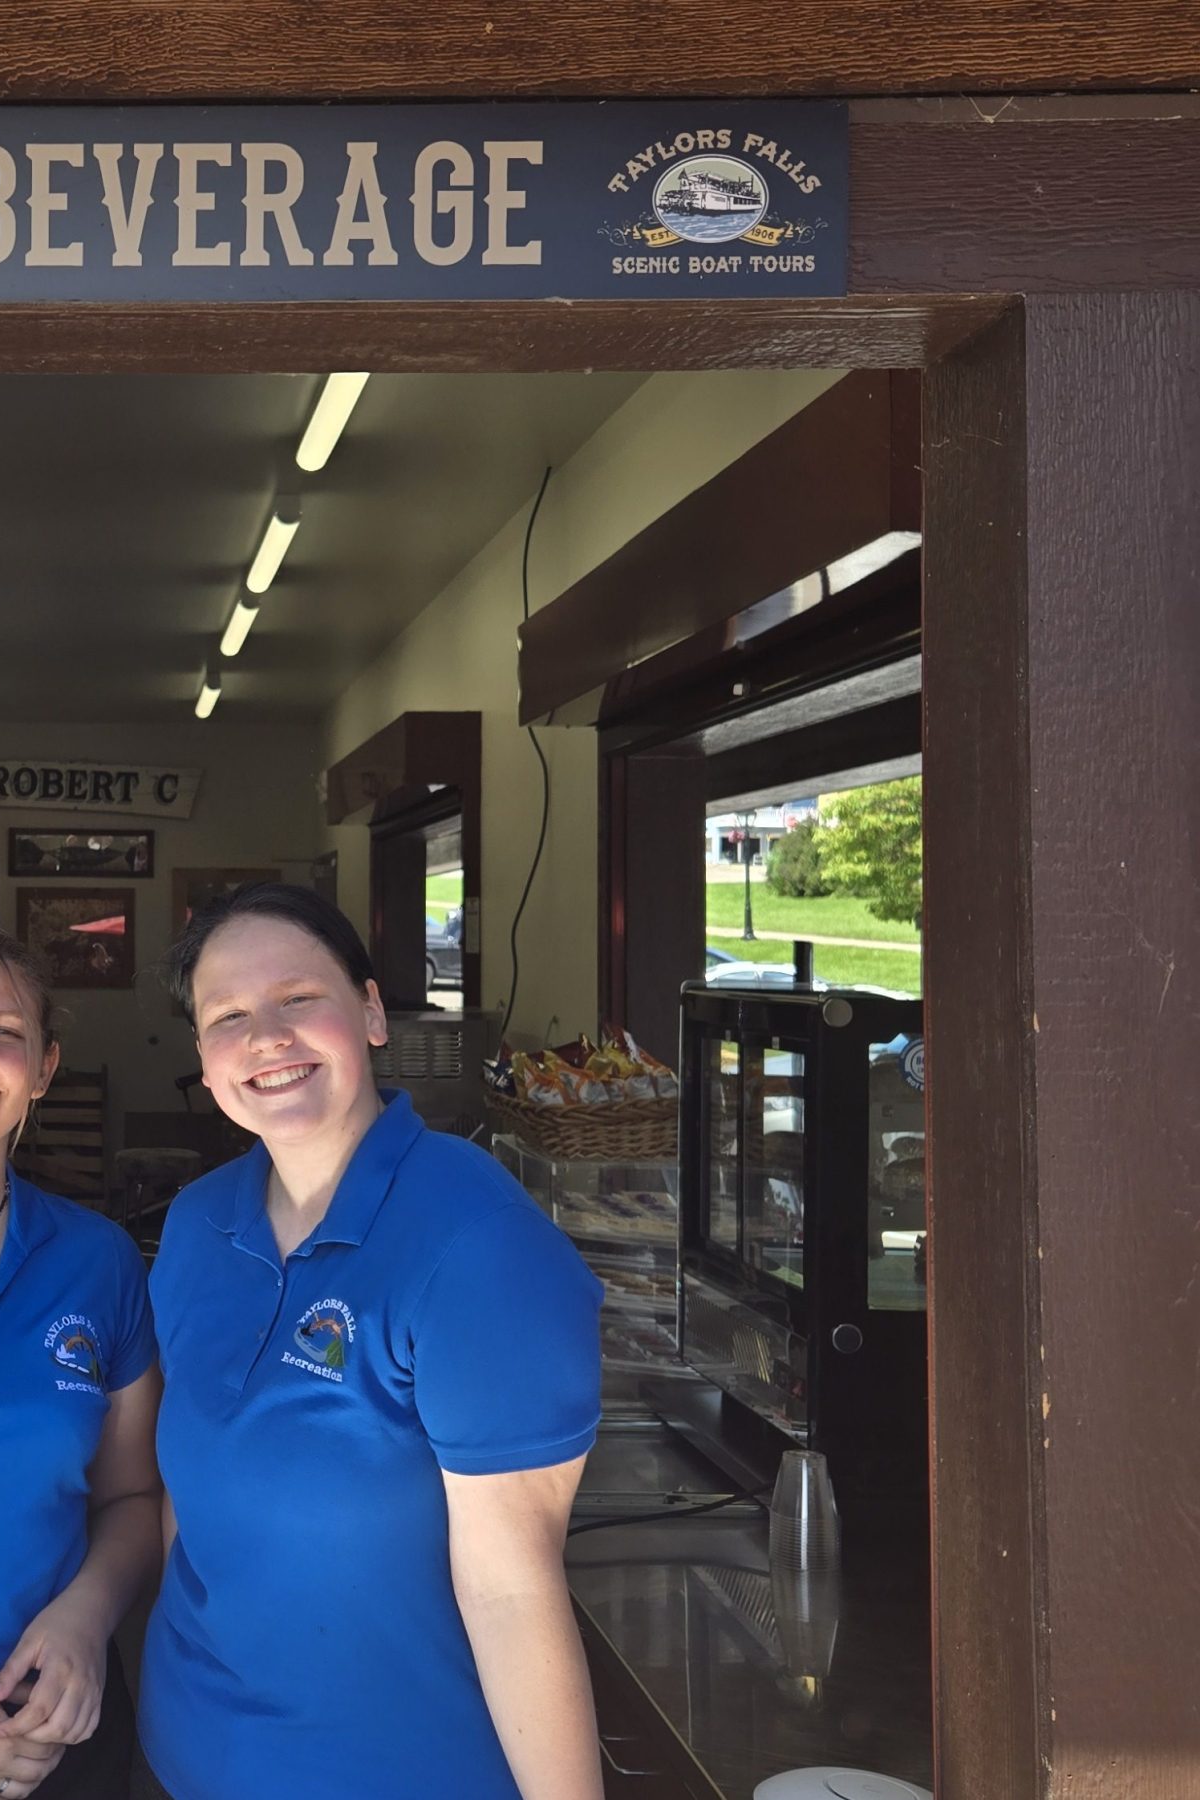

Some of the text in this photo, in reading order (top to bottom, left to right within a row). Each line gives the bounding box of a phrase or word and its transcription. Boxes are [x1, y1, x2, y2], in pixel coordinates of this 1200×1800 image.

[607, 128, 822, 194] TAYLORS FALLS
[751, 227, 775, 240] 1906
[612, 254, 816, 274] SCENIC BOAT TOURS
[155, 773, 180, 804] C
[297, 1298, 344, 1325] TAYLORS
[43, 1314, 85, 1349] TAYLORS
[280, 1351, 343, 1383] Recreation
